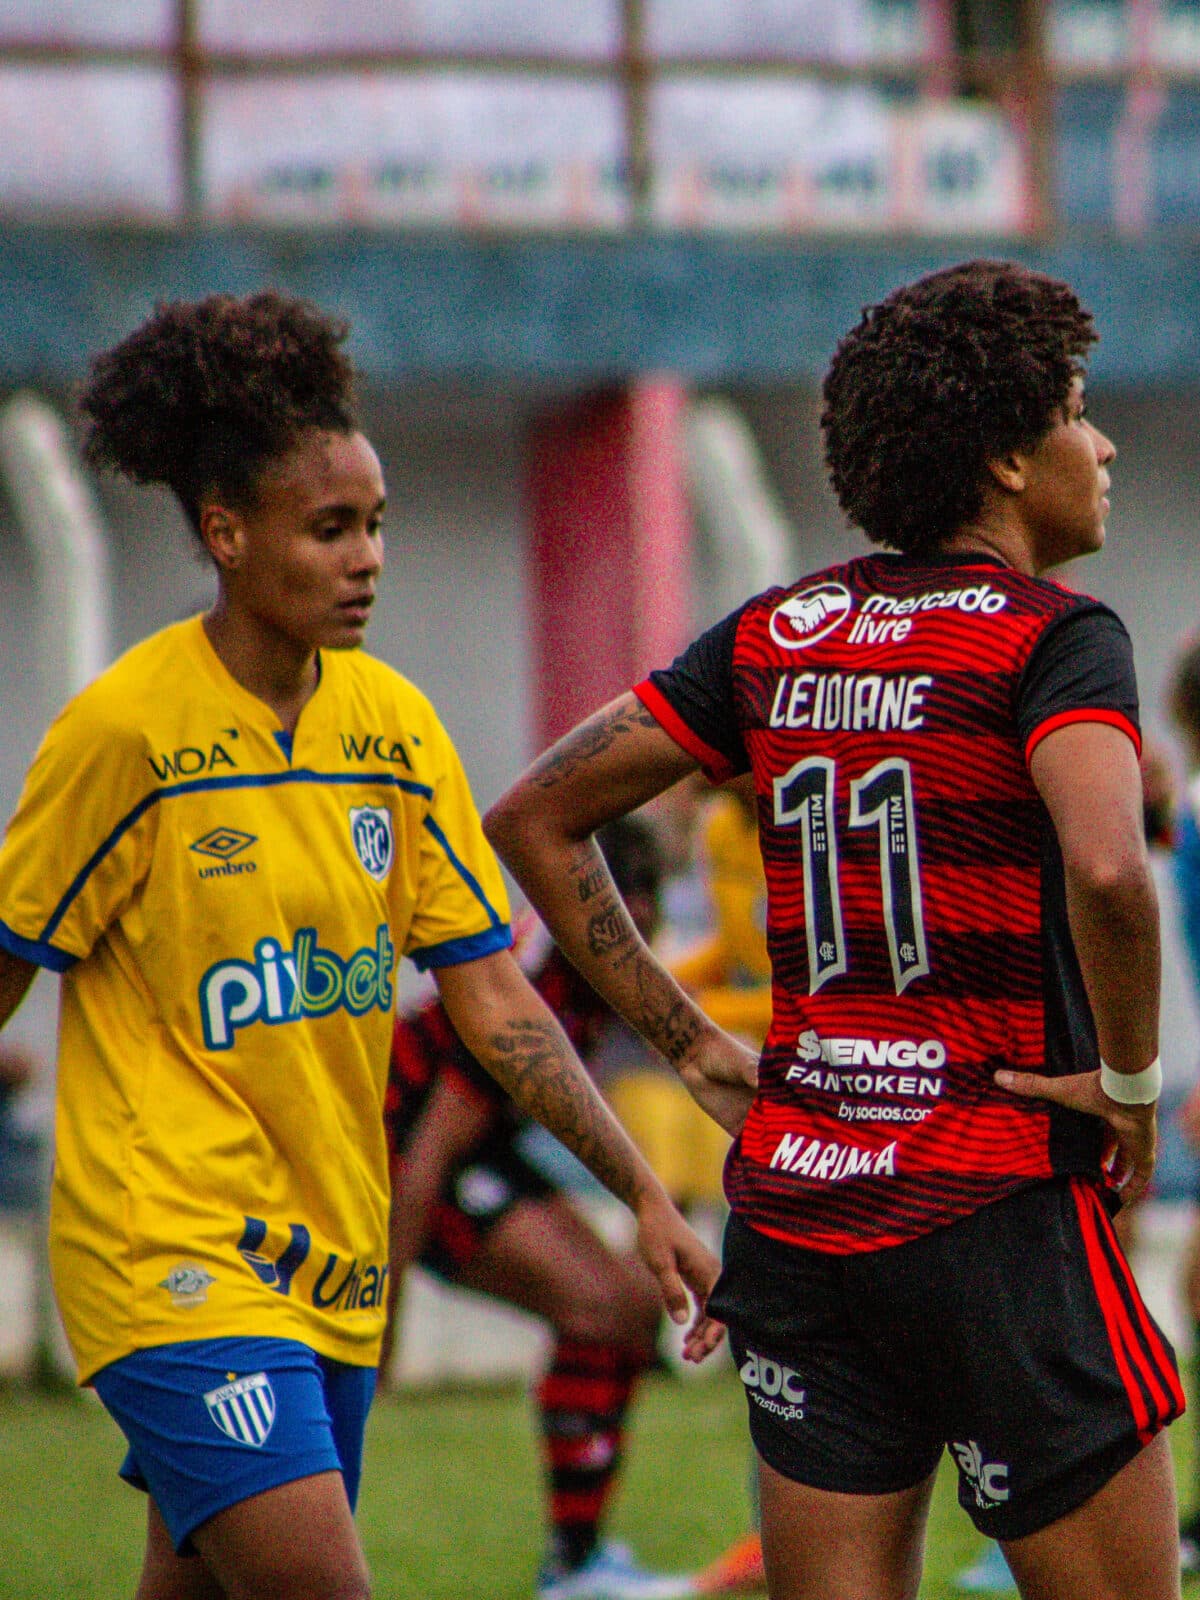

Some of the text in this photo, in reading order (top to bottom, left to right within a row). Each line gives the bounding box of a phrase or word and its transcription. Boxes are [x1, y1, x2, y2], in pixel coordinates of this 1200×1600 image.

[860, 584, 1007, 615] mercado
[847, 614, 913, 645] livre
[769, 673, 933, 731] LEIDIANE
[147, 743, 239, 781] WOA
[198, 860, 257, 879] umbro
[772, 755, 930, 997] 11
[199, 922, 396, 1051] pixbet
